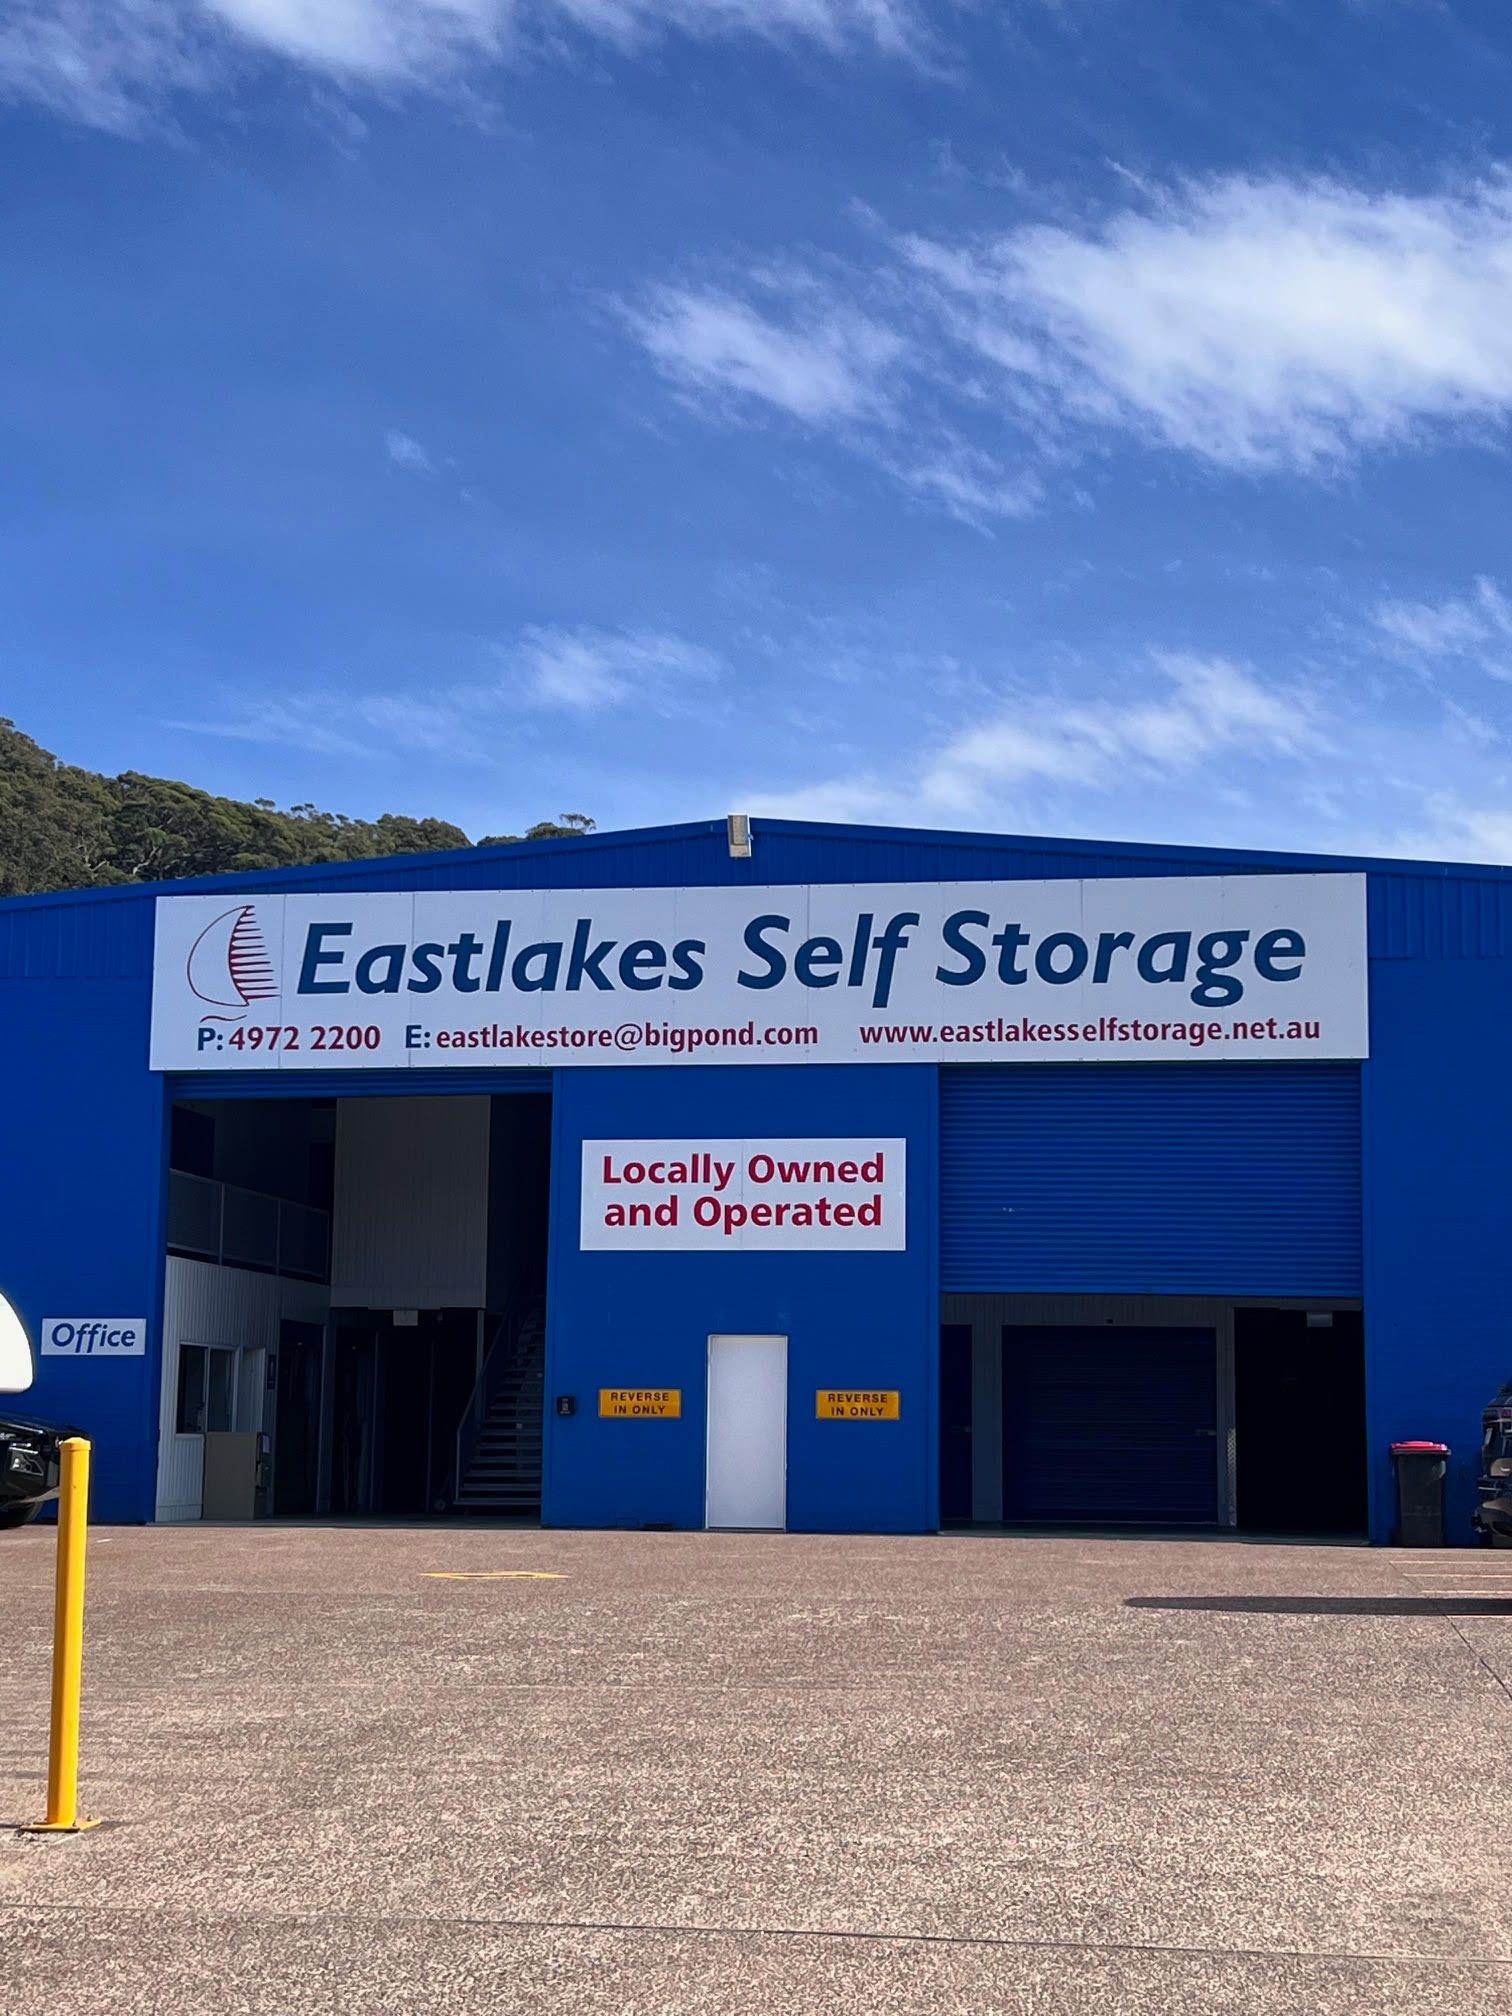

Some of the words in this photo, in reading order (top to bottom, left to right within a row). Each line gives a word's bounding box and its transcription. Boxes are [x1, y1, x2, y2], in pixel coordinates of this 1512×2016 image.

[297, 919, 705, 994] Eastlakes
[738, 913, 920, 1008] Self
[936, 910, 1305, 1007] Storage
[311, 1026, 380, 1049] 2200
[860, 1017, 1319, 1046] www.eastlakesselfstorage.net.au
[603, 1153, 735, 1191] Locally
[749, 1153, 883, 1183] Owned
[605, 1195, 677, 1226] and
[694, 1195, 881, 1234] Operated
[52, 1323, 135, 1353] Office
[611, 1392, 668, 1401] REVERSE
[615, 1406, 626, 1414] IN
[633, 1406, 665, 1414] ONLY
[828, 1394, 887, 1403] REVERSE
[832, 1407, 844, 1415] IN
[850, 1407, 883, 1416] ONLY
